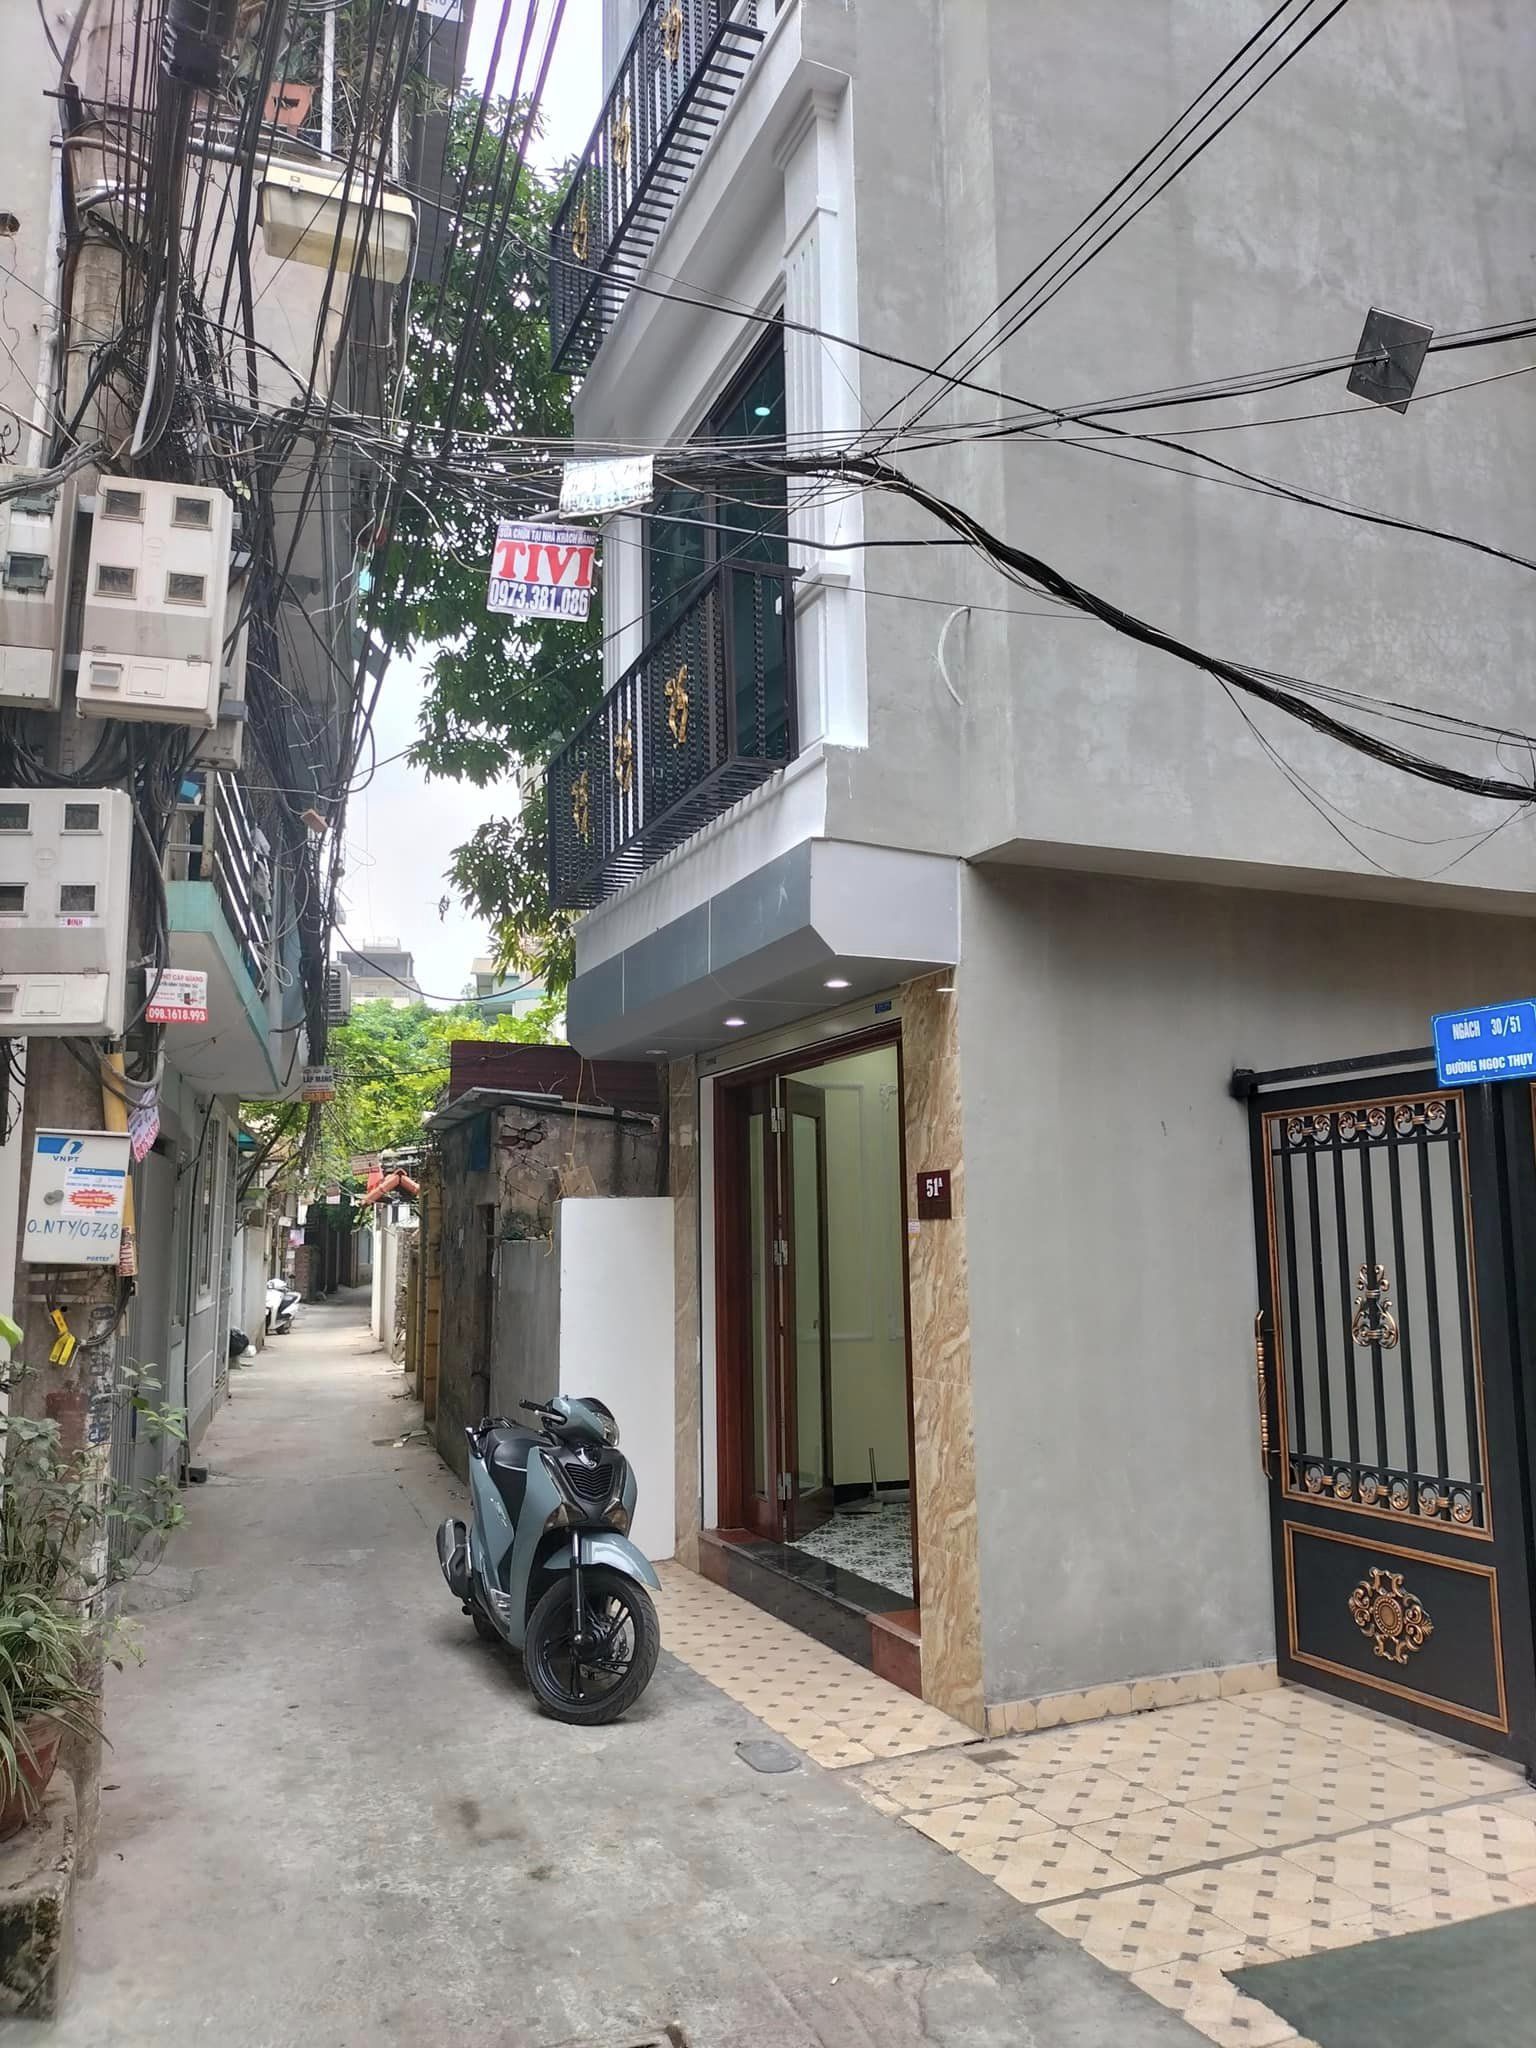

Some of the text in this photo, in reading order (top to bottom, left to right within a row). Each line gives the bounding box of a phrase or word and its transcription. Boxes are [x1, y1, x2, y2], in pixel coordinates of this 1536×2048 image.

[496, 540, 594, 587] TIVI
[490, 579, 588, 616] 0973.381.086
[149, 1007, 206, 1021] 098.1618.993
[1452, 1015, 1521, 1040] NGÁCH 30/51
[1445, 1052, 1534, 1075] ĐƯỜNG NGỌC THỤY
